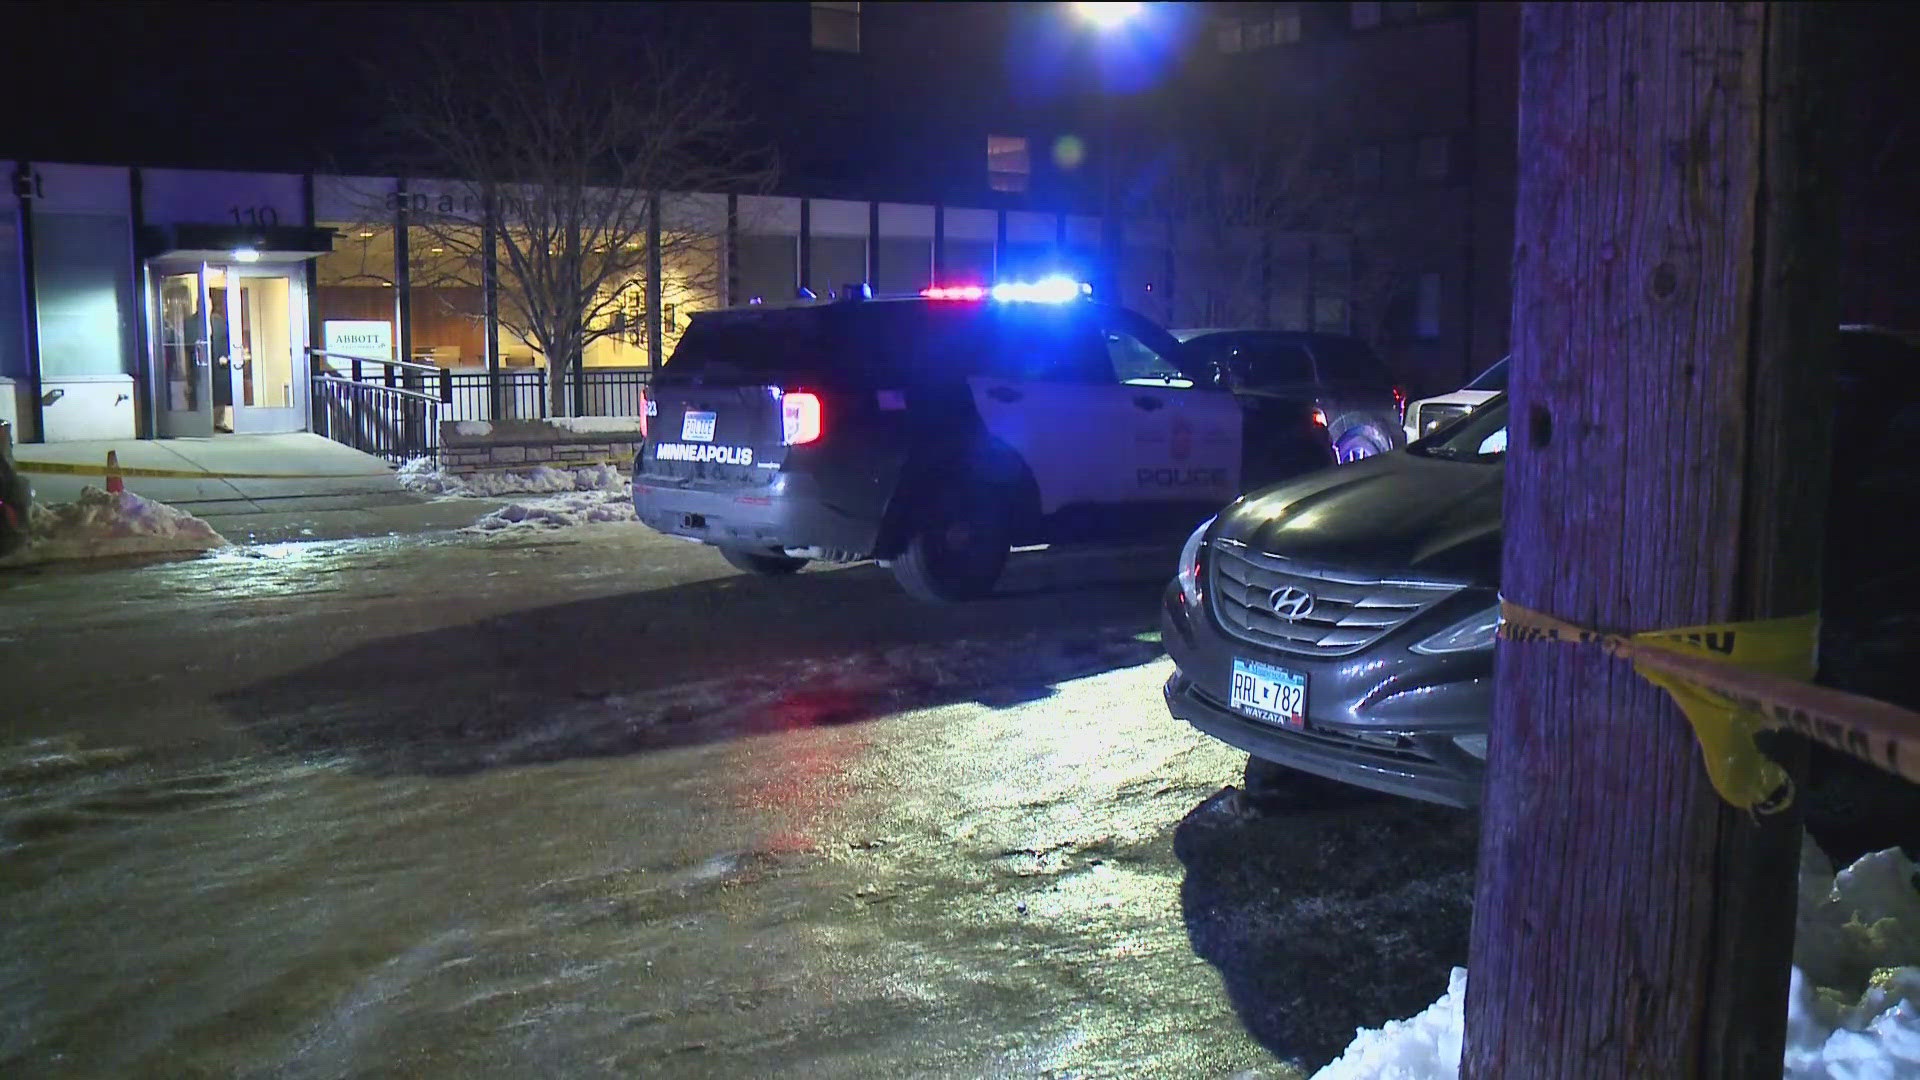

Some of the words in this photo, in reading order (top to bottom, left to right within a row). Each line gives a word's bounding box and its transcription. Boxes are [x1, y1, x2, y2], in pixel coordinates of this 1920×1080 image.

[227, 206, 278, 225] 110
[336, 334, 379, 344] ABBOTT
[656, 442, 753, 466] MINNEAPOLIS
[1137, 467, 1227, 487] POLICE
[1234, 673, 1260, 704] RRL
[1273, 682, 1301, 714] 782
[1243, 705, 1285, 725] WAYZATA
